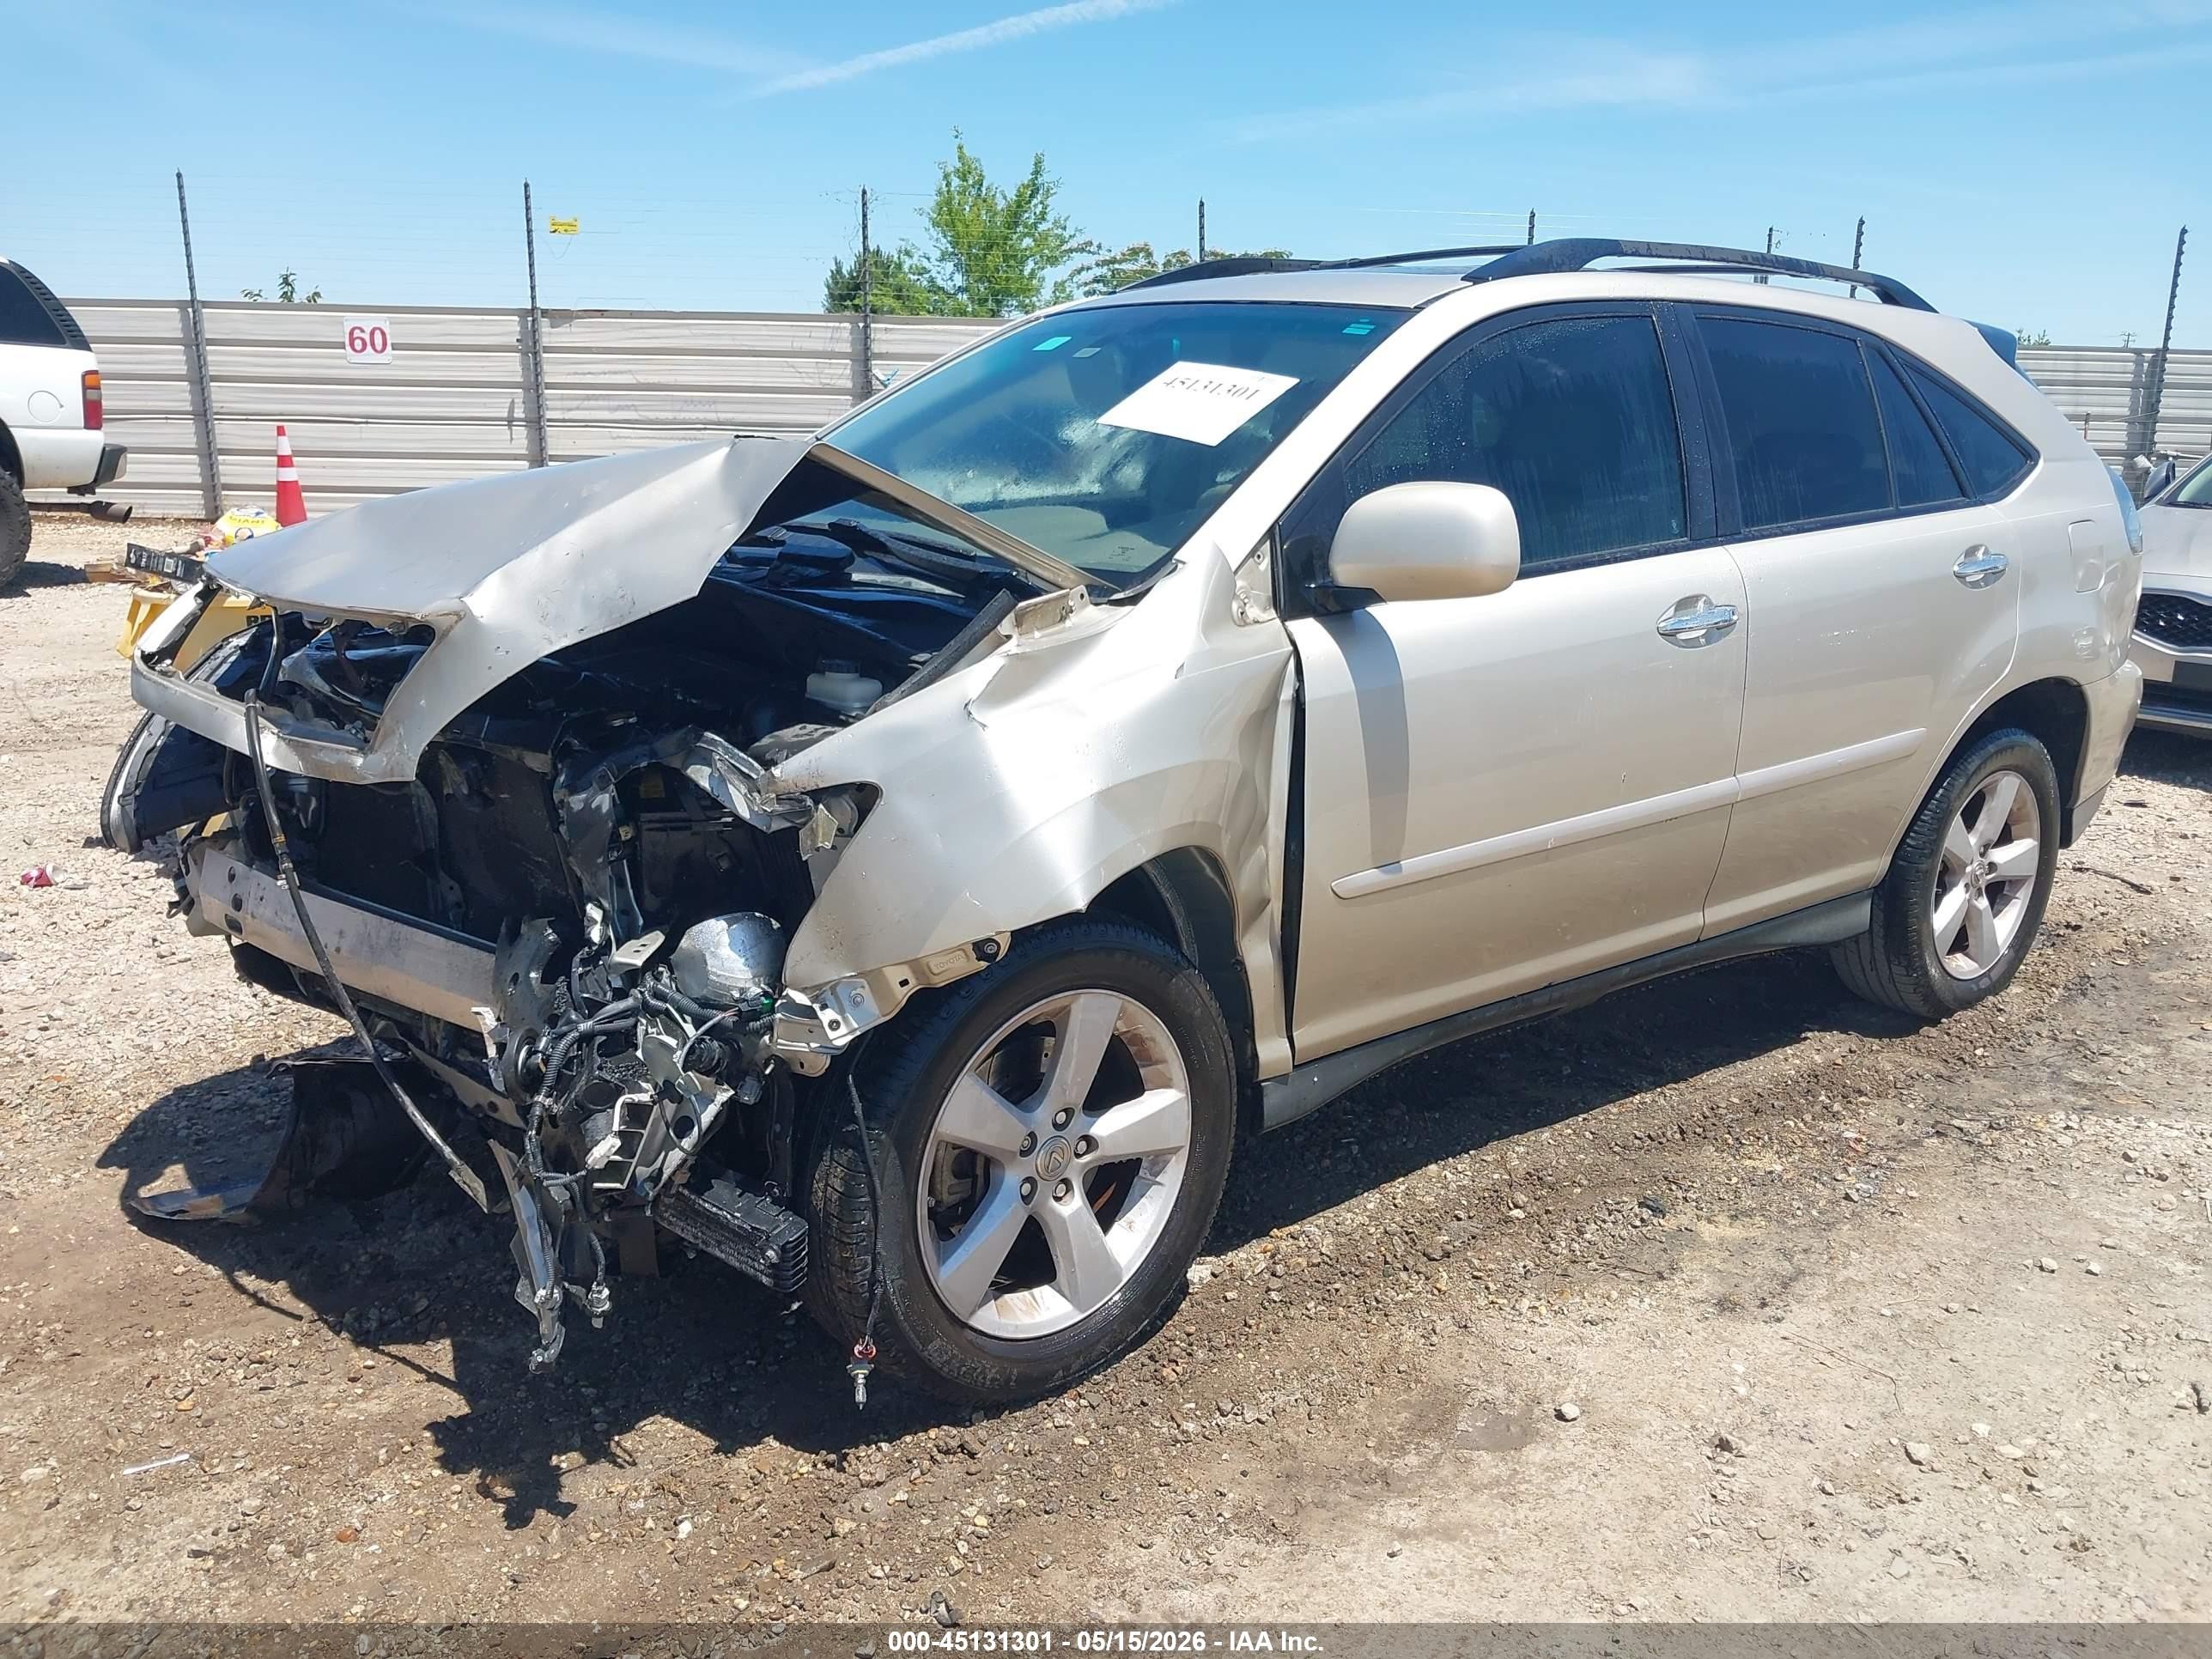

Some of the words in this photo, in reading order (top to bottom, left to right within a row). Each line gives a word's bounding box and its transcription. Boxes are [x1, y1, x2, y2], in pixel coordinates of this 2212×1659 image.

[348, 325, 388, 355] 60
[1164, 377, 1261, 400] 45131301
[933, 953, 964, 970] TOYOTA
